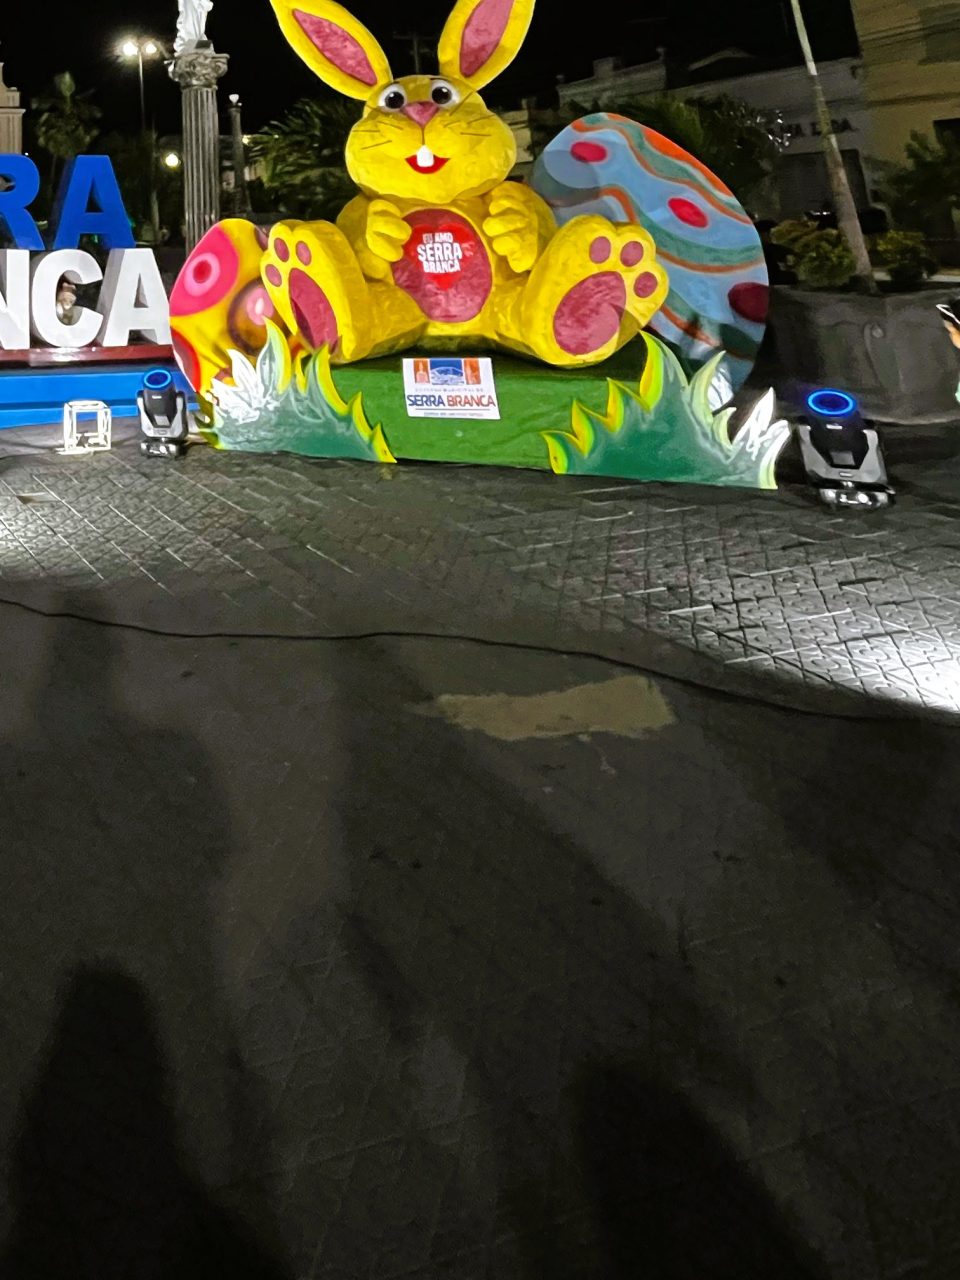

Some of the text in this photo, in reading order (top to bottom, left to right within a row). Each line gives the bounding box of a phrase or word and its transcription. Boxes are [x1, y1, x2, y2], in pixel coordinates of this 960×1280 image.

[416, 242, 463, 261] SERRA
[422, 260, 461, 273] BRANCA
[406, 394, 496, 407] SERRA BRANCA
